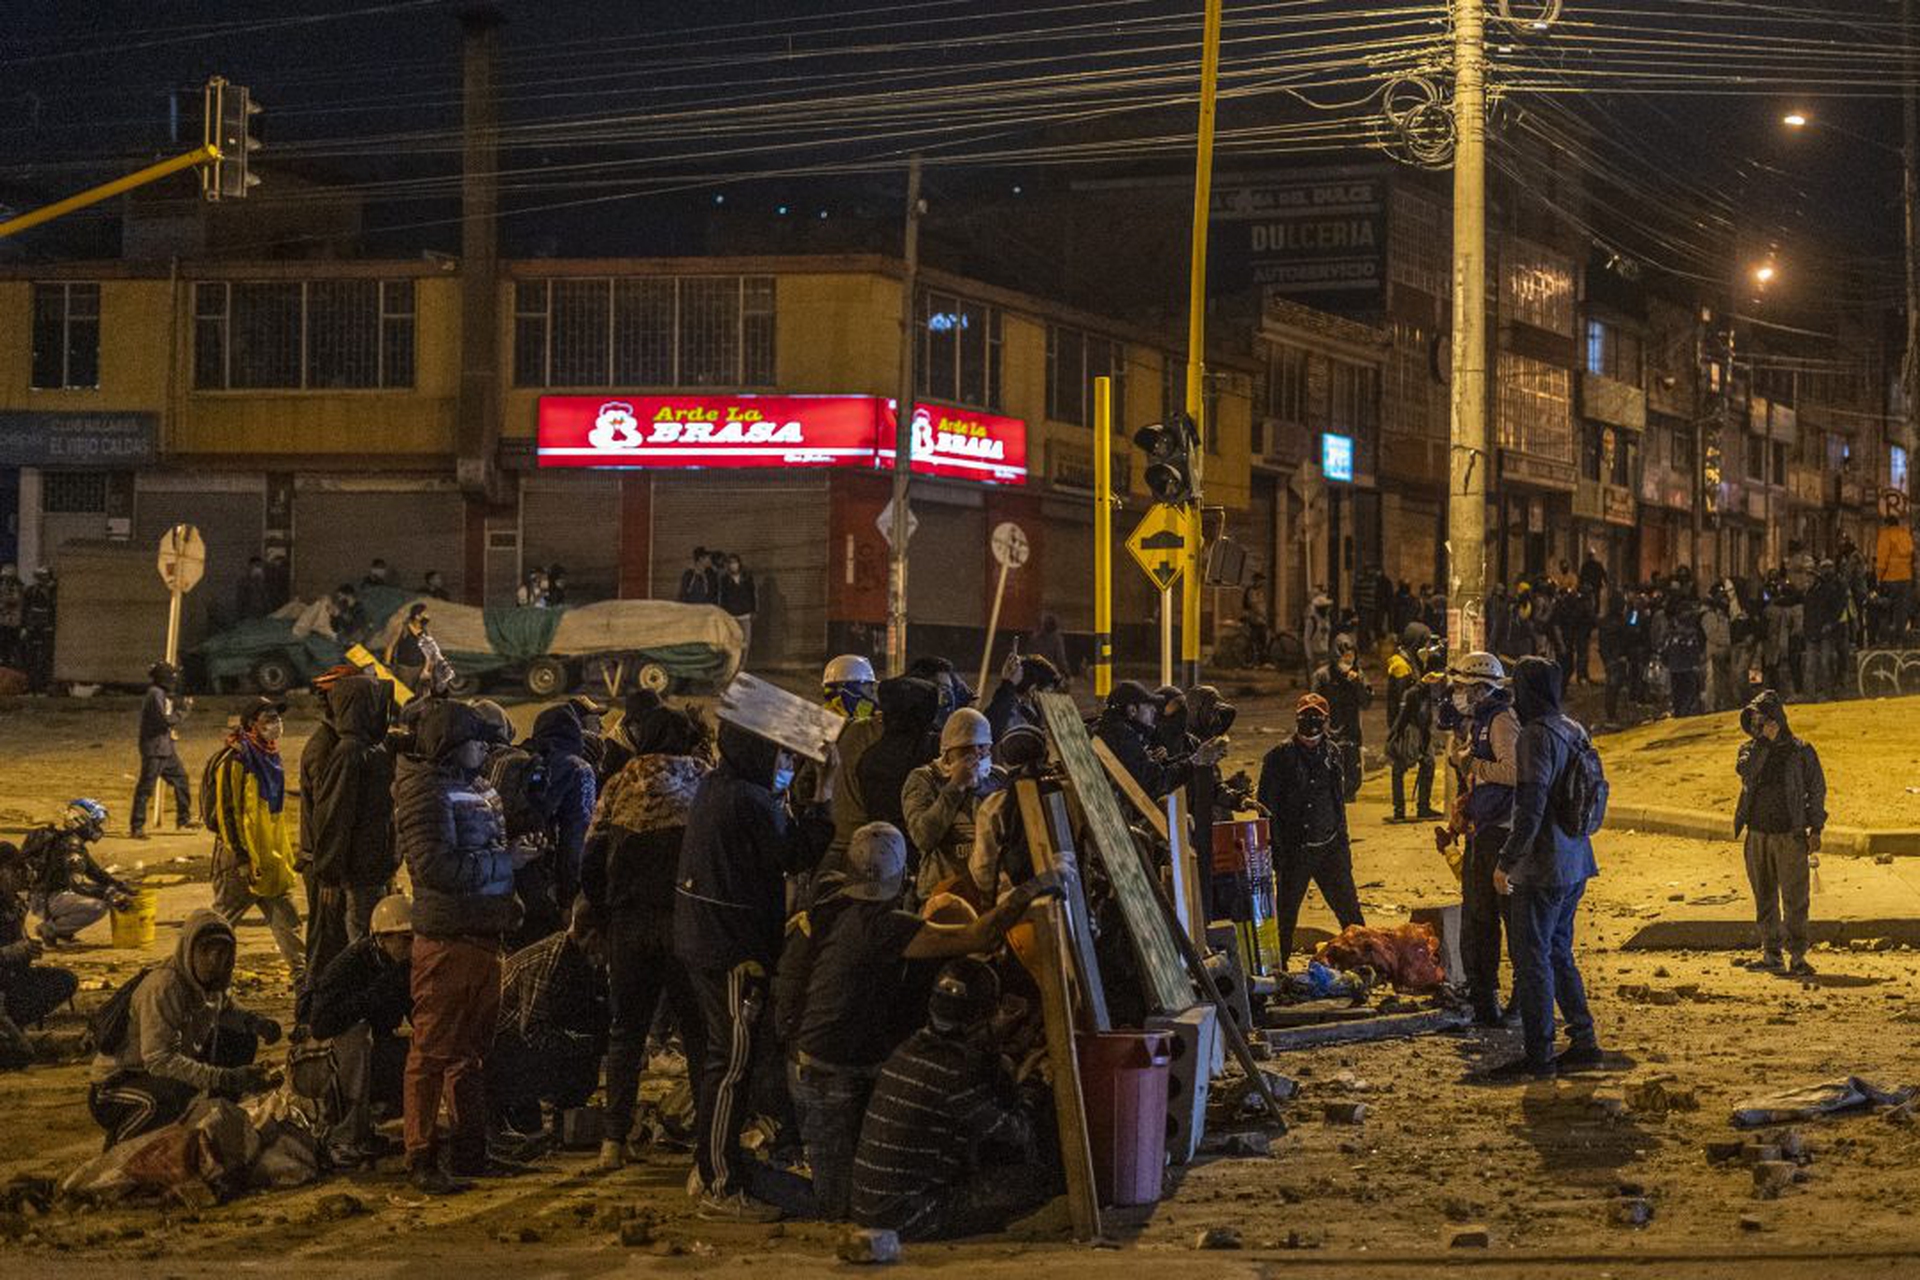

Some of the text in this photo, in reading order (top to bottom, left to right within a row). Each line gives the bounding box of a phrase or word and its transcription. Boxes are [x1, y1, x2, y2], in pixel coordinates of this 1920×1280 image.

[1313, 185, 1372, 204] DULCE
[1251, 220, 1375, 252] DULCERIA
[653, 406, 763, 422] Arde La
[646, 422, 804, 444] BRASA
[937, 417, 969, 436] Arde
[101, 436, 149, 455] CALDAS
[936, 433, 1005, 460] BRASA
